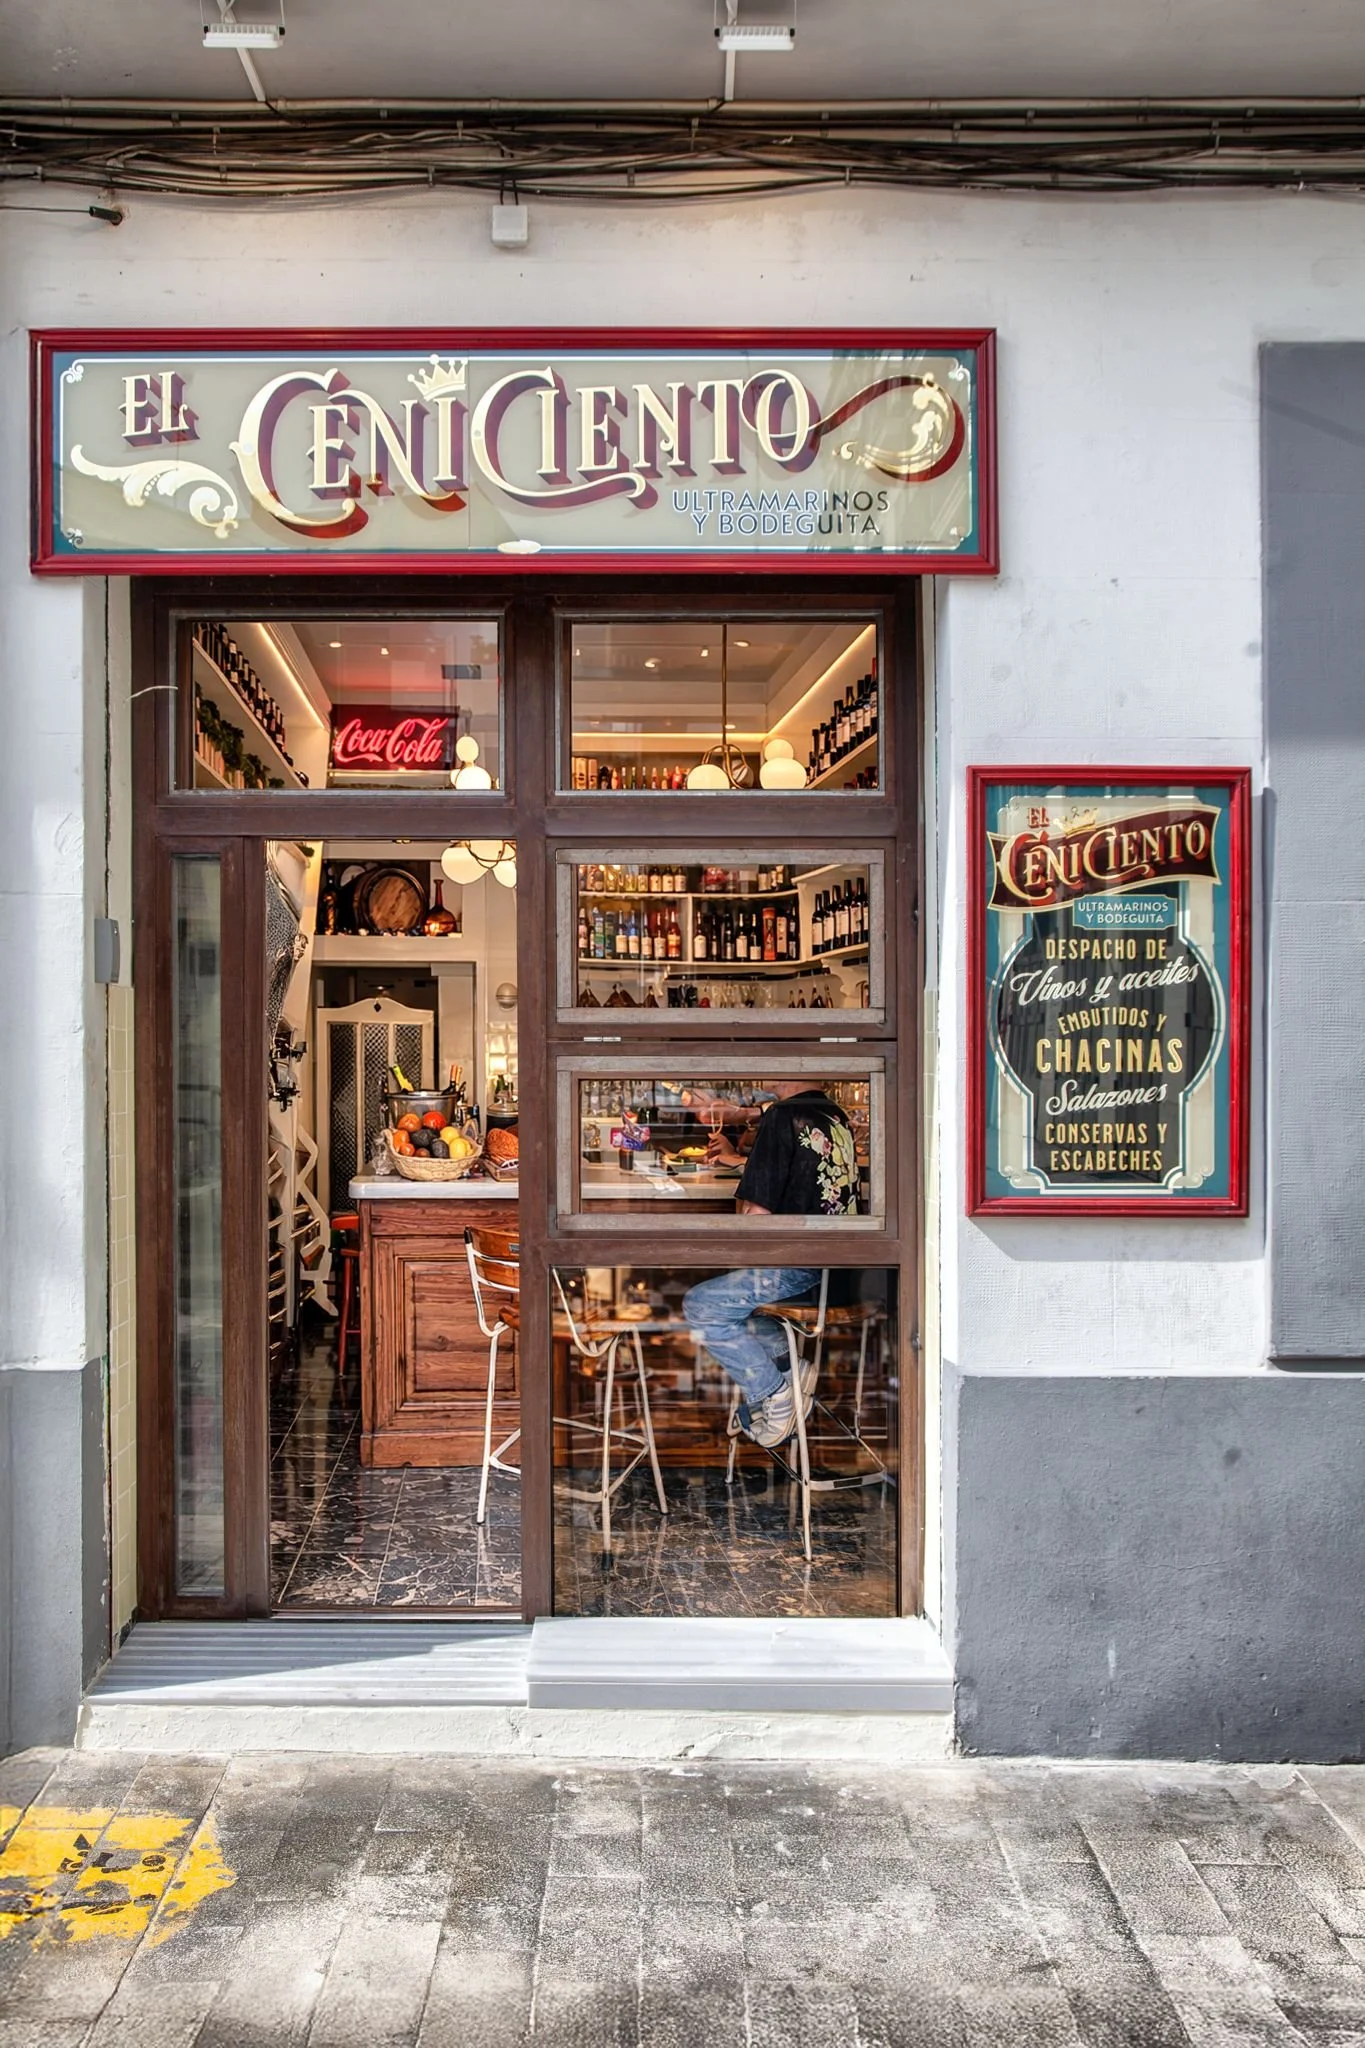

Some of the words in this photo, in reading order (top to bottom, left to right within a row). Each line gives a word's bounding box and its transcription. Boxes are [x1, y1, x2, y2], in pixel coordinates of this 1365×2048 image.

[119, 371, 199, 447] EL
[229, 366, 820, 538] CENICIENTO
[672, 490, 890, 512] ULTRAMARINOS
[692, 513, 708, 536] Y
[718, 513, 881, 536] BODEGUITA
[1027, 806, 1051, 829] EL
[997, 820, 1210, 906] CENICIENTO
[1078, 902, 1169, 912] ULTRAMARINOS
[1086, 914, 1094, 924] Y
[1096, 914, 1165, 924] BODEGUITA
[1045, 938, 1137, 960] DESPACHO
[1146, 938, 1168, 960] DE
[1009, 966, 1087, 1006] Vinos
[1089, 975, 1114, 1003] y
[1118, 956, 1200, 991] aceites
[1057, 1006, 1149, 1035] EMBUTIDOS
[1155, 1014, 1168, 1033] Y
[1036, 1038, 1183, 1073] CHACINAS
[1045, 1079, 1169, 1116] Salazones
[1045, 1122, 1148, 1144] CONSERVAS
[1157, 1122, 1168, 1144] Y
[1050, 1150, 1163, 1171] ESCABECHES
